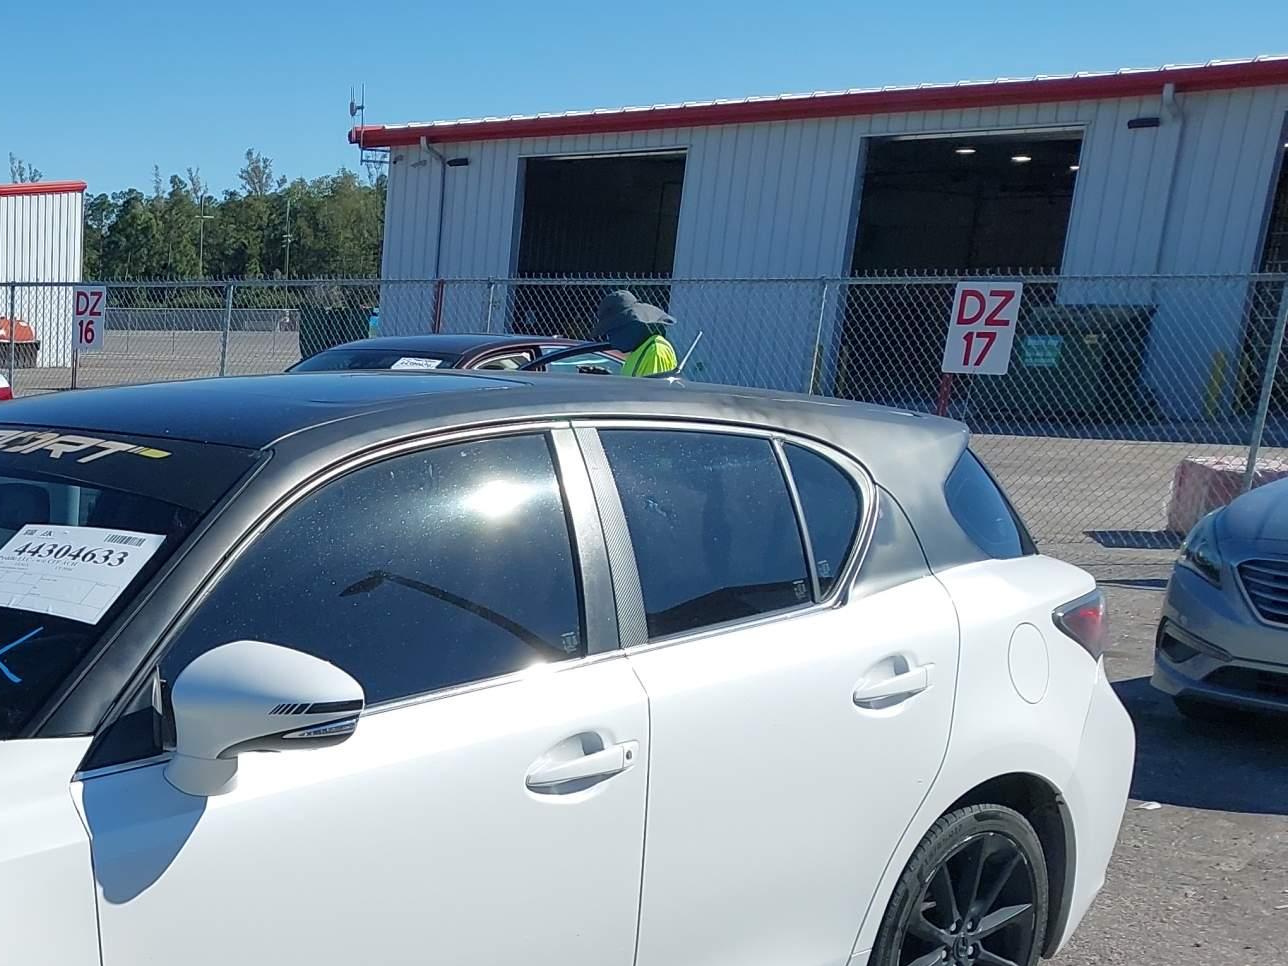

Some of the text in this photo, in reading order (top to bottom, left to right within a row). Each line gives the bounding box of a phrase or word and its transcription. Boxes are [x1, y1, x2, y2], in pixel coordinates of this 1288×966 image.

[75, 290, 103, 316] DZ
[956, 289, 1016, 327] DZ
[78, 319, 95, 344] 16
[962, 331, 997, 366] 17
[13, 541, 129, 567] 44304633
